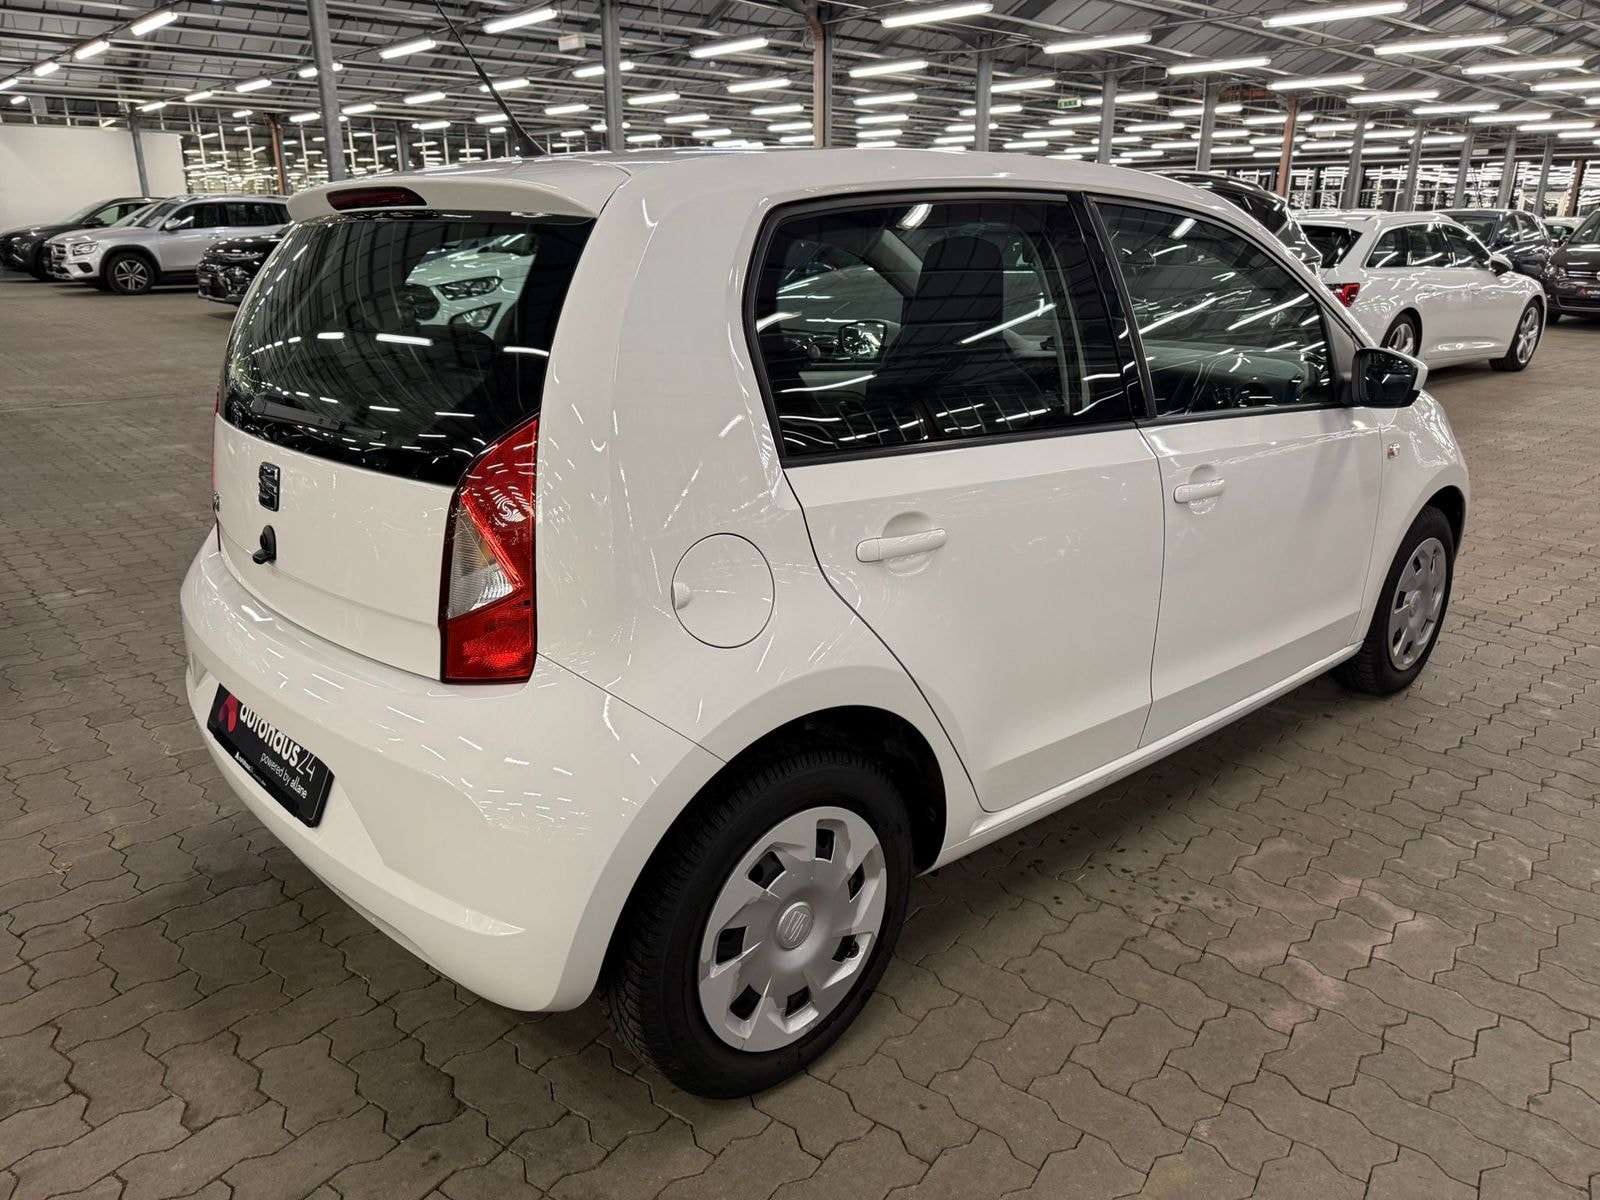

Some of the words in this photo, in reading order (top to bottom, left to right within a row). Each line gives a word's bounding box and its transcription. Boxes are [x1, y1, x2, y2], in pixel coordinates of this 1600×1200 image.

[260, 752, 285, 778] powered
[282, 769, 292, 786] by
[290, 775, 308, 799] allane
